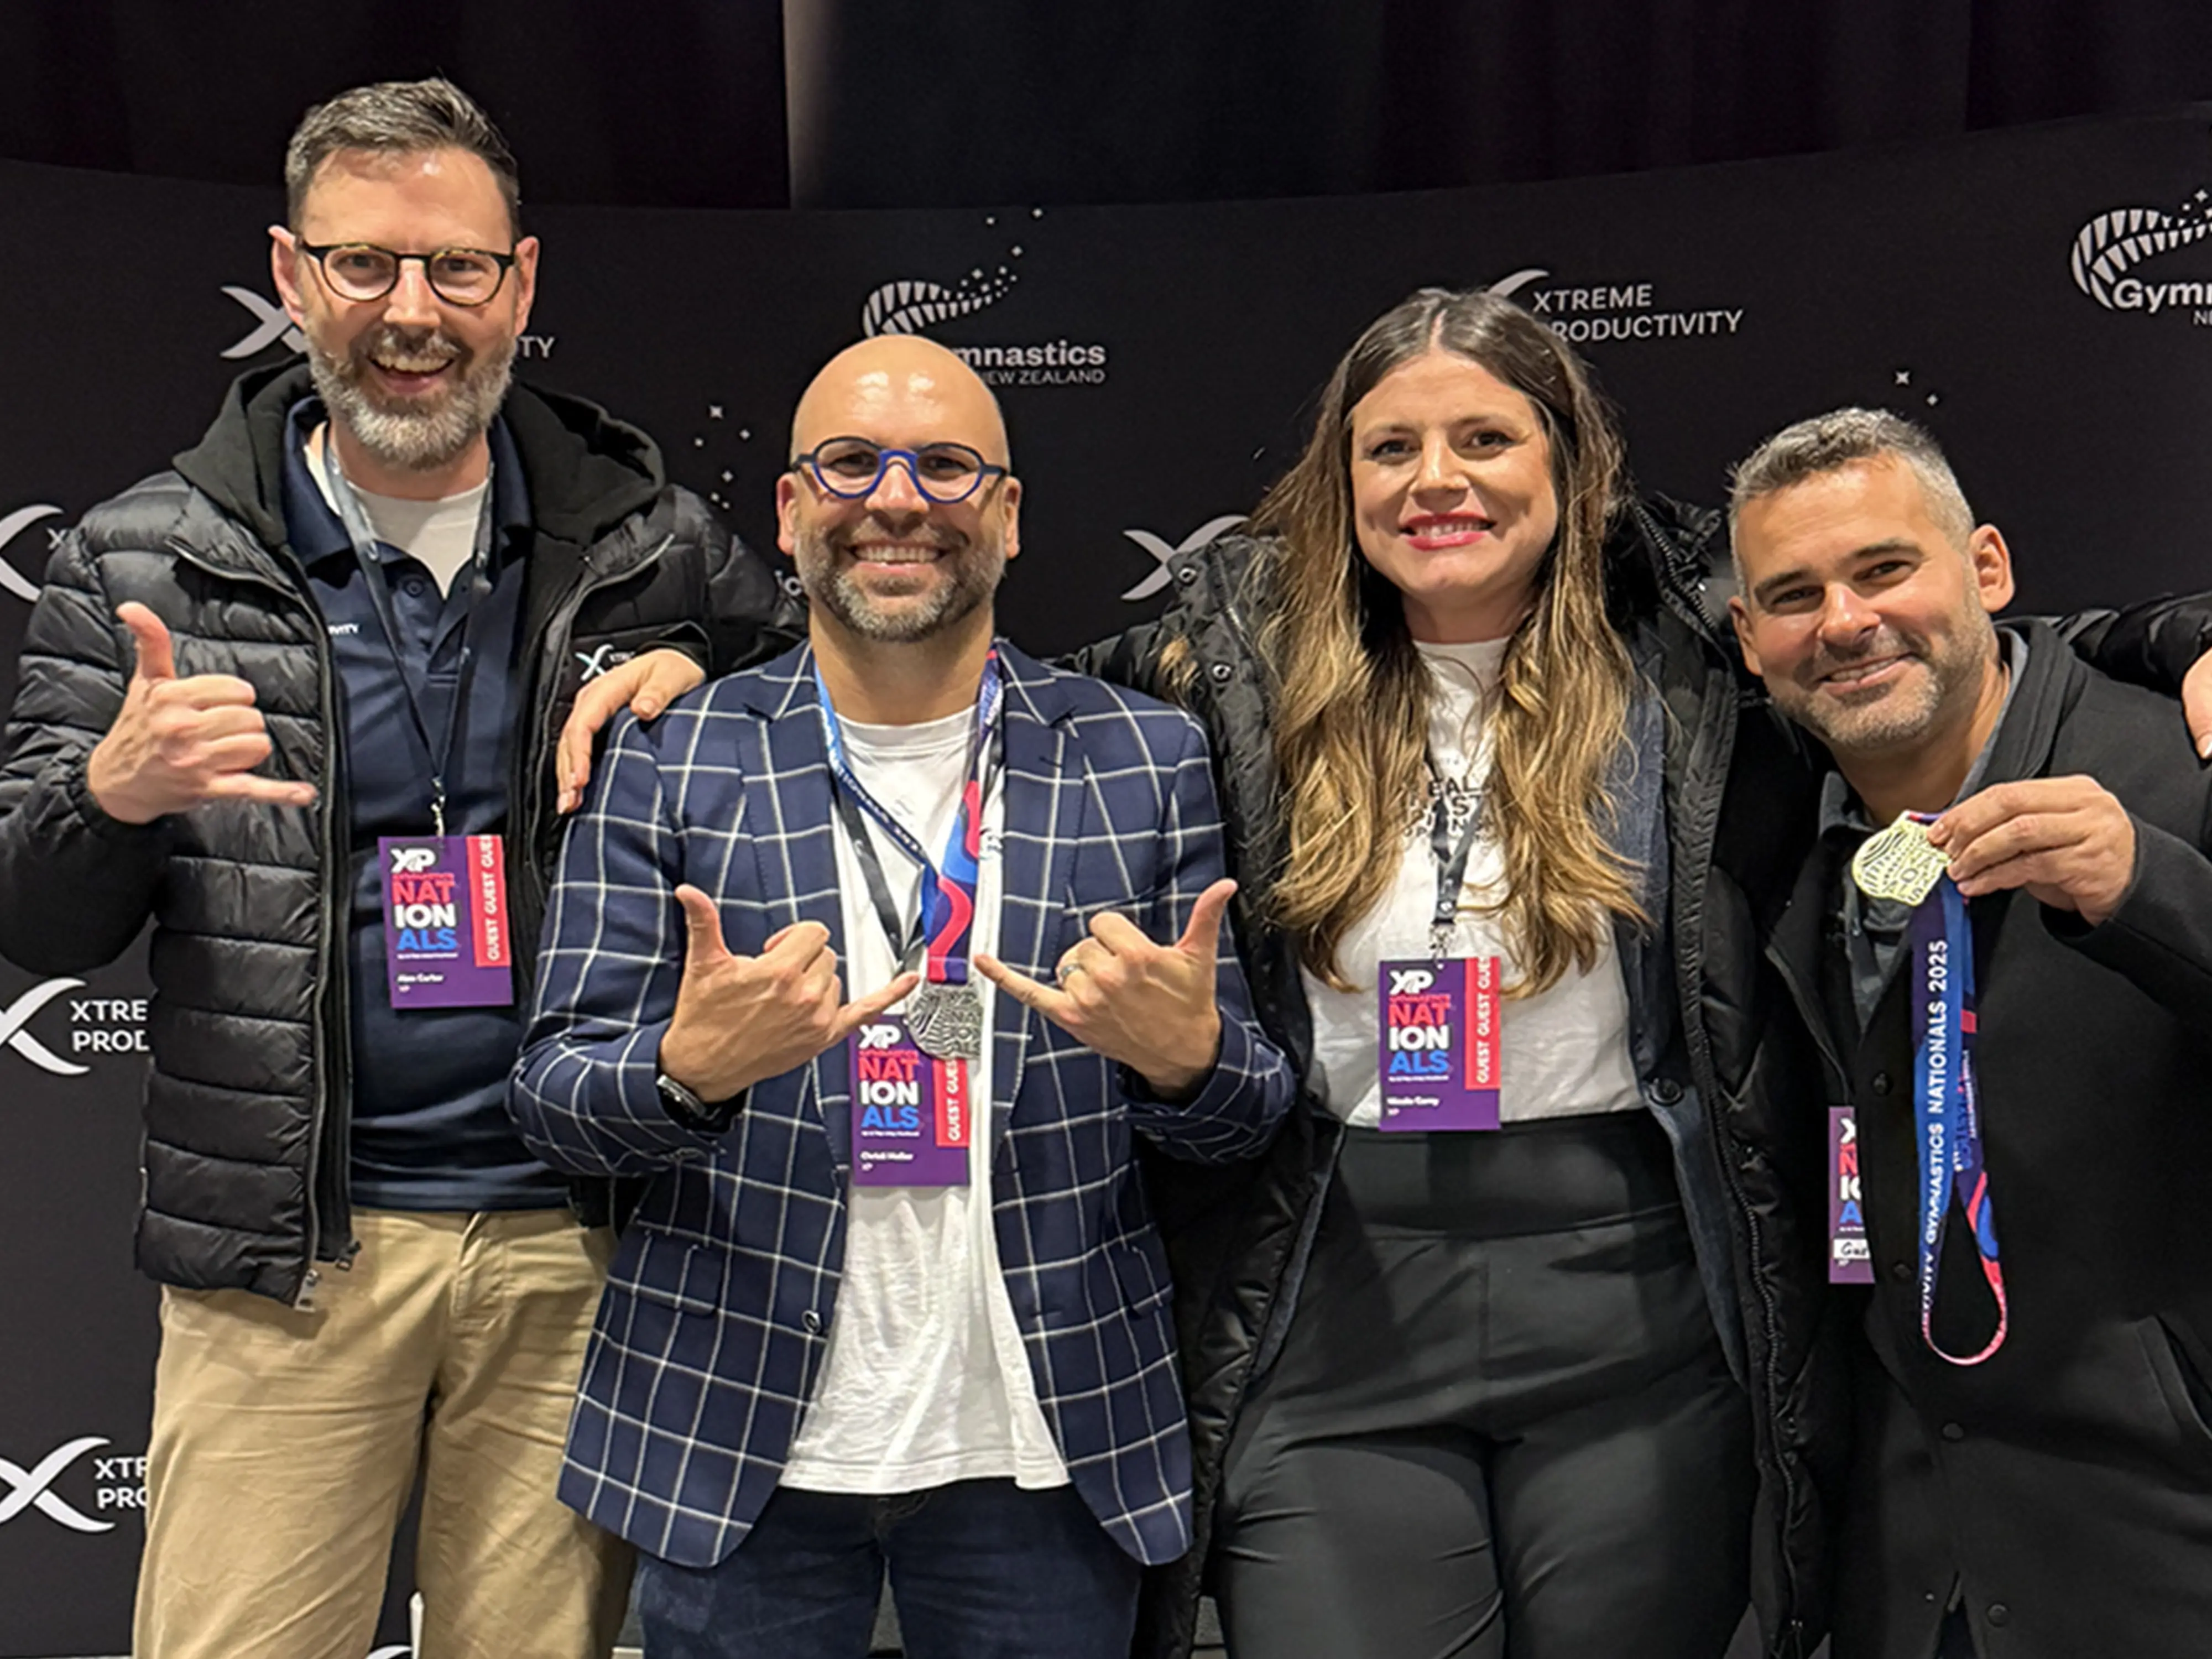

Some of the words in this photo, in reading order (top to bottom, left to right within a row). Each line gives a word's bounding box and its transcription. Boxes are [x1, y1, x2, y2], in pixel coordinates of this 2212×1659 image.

[1533, 284, 1653, 313] XTREME
[1550, 309, 1744, 342] RODUCTIVITY
[951, 339, 1105, 367] mnastics
[1018, 369, 1105, 384] ZEALAND
[390, 848, 436, 873] XP
[392, 880, 455, 904] NAT
[482, 872, 496, 914] GUEST
[394, 904, 456, 928] ION
[396, 928, 458, 953] ALS
[487, 918, 499, 961] GUEST
[1928, 940, 1948, 992] 2025
[1389, 970, 1433, 995] XP
[70, 999, 148, 1022] XTRE
[1389, 1002, 1451, 1026] NAT
[1478, 994, 1490, 1035] GUEST
[858, 1024, 901, 1049] XP
[1389, 1025, 1449, 1050] ION
[858, 1057, 920, 1081] NAT
[1389, 1050, 1449, 1074] ALS
[1478, 1042, 1489, 1082] GUEST
[1927, 1000, 1948, 1114] NATIONALS
[860, 1080, 919, 1105] ION
[860, 1105, 920, 1129] ALS
[947, 1099, 960, 1140] GUEST
